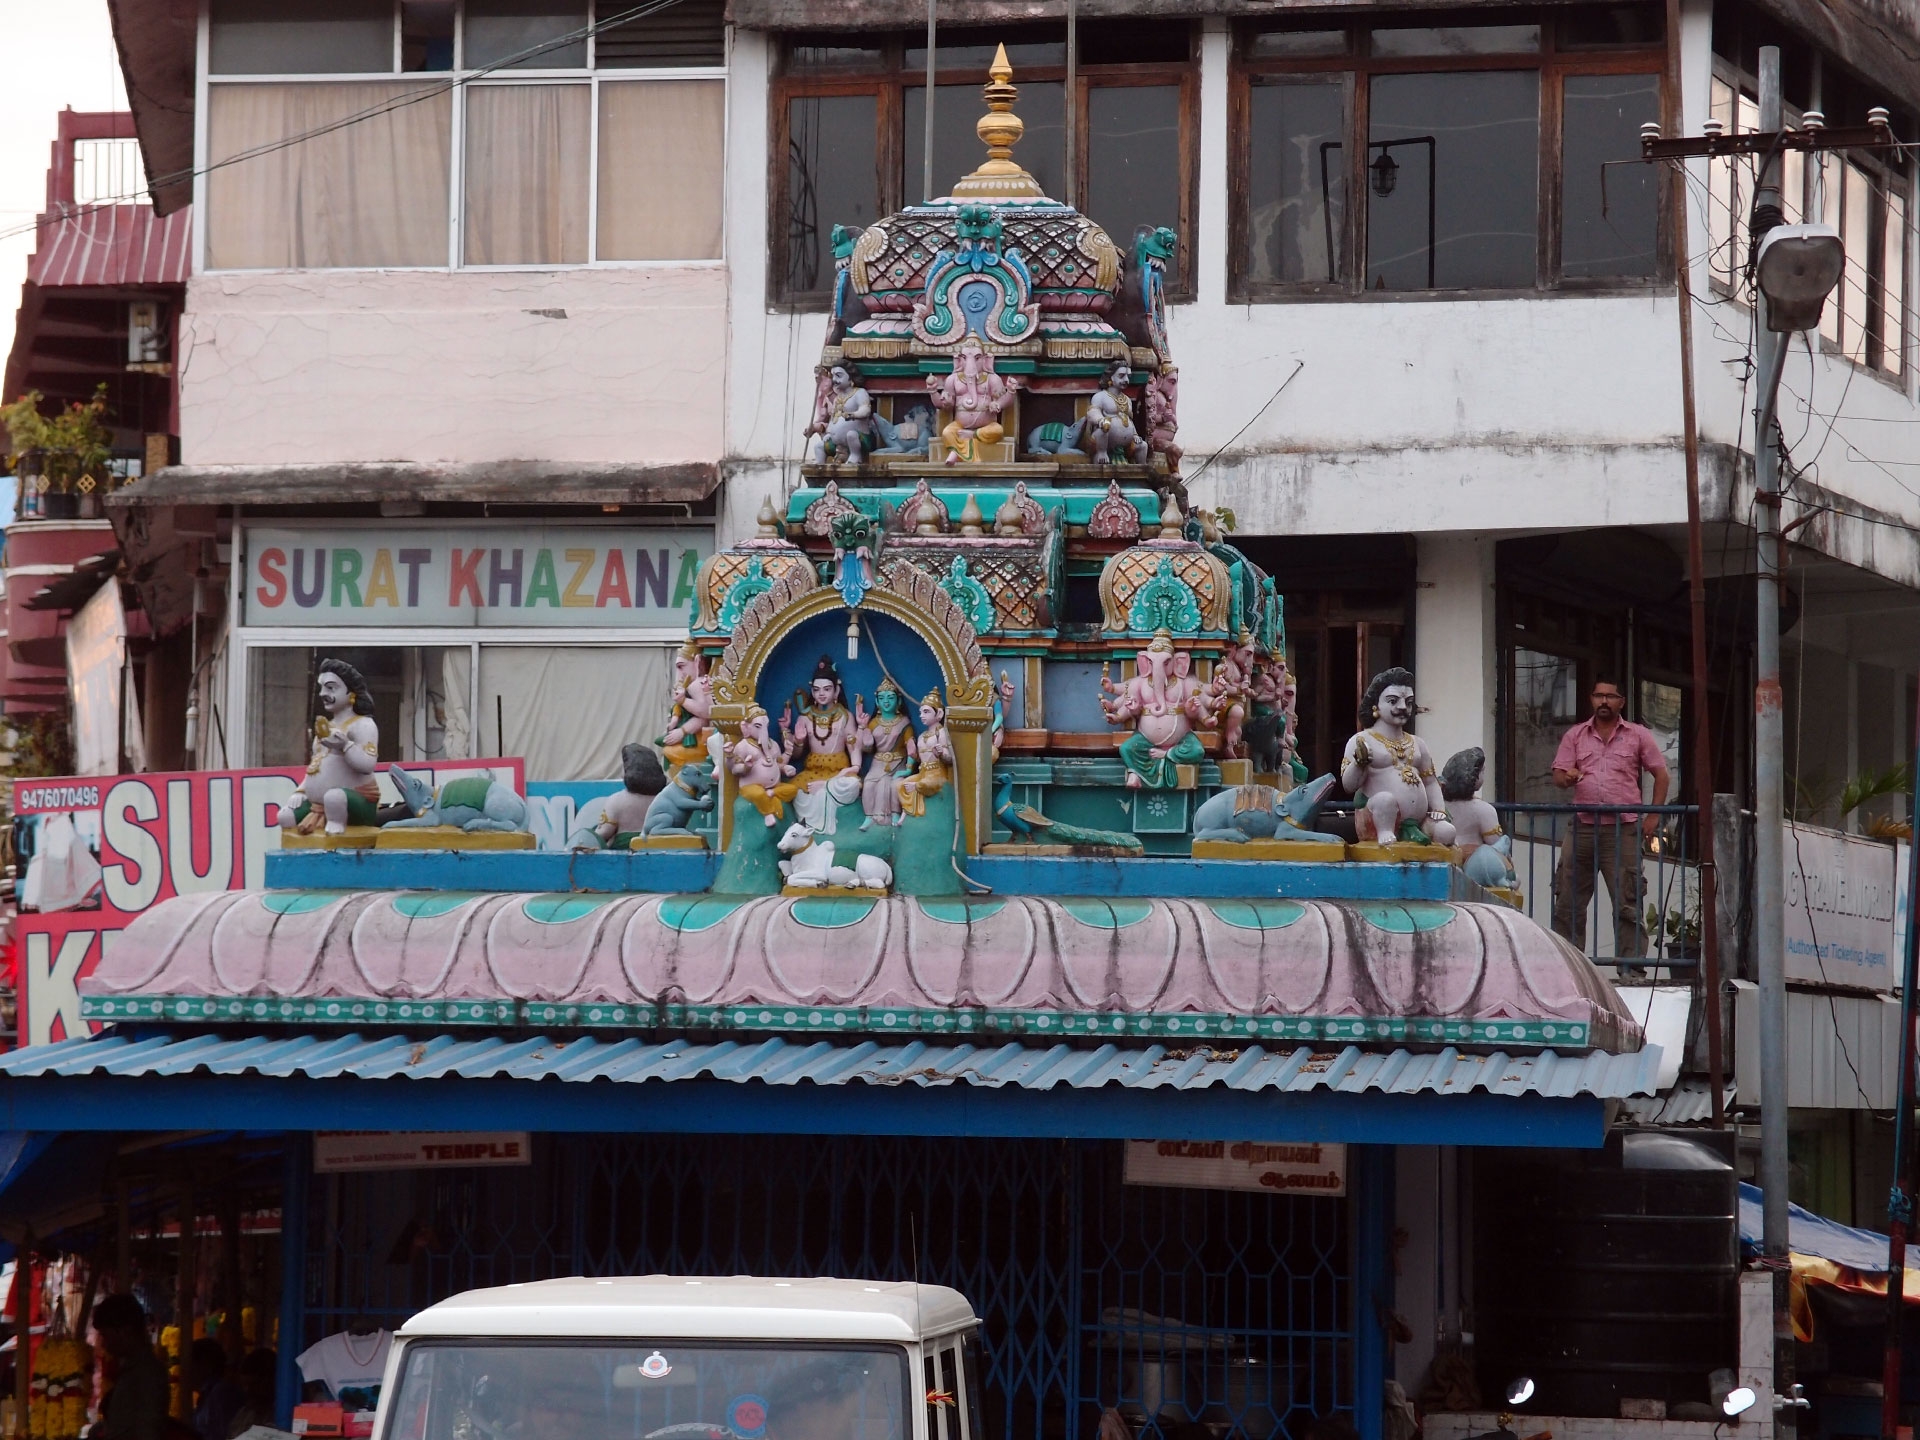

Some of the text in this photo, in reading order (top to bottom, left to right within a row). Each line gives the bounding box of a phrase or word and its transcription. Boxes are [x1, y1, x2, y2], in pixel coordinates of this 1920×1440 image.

[256, 548, 431, 608] SURAT
[21, 785, 99, 809] 9476070496
[421, 1142, 520, 1160] TEMPLE
